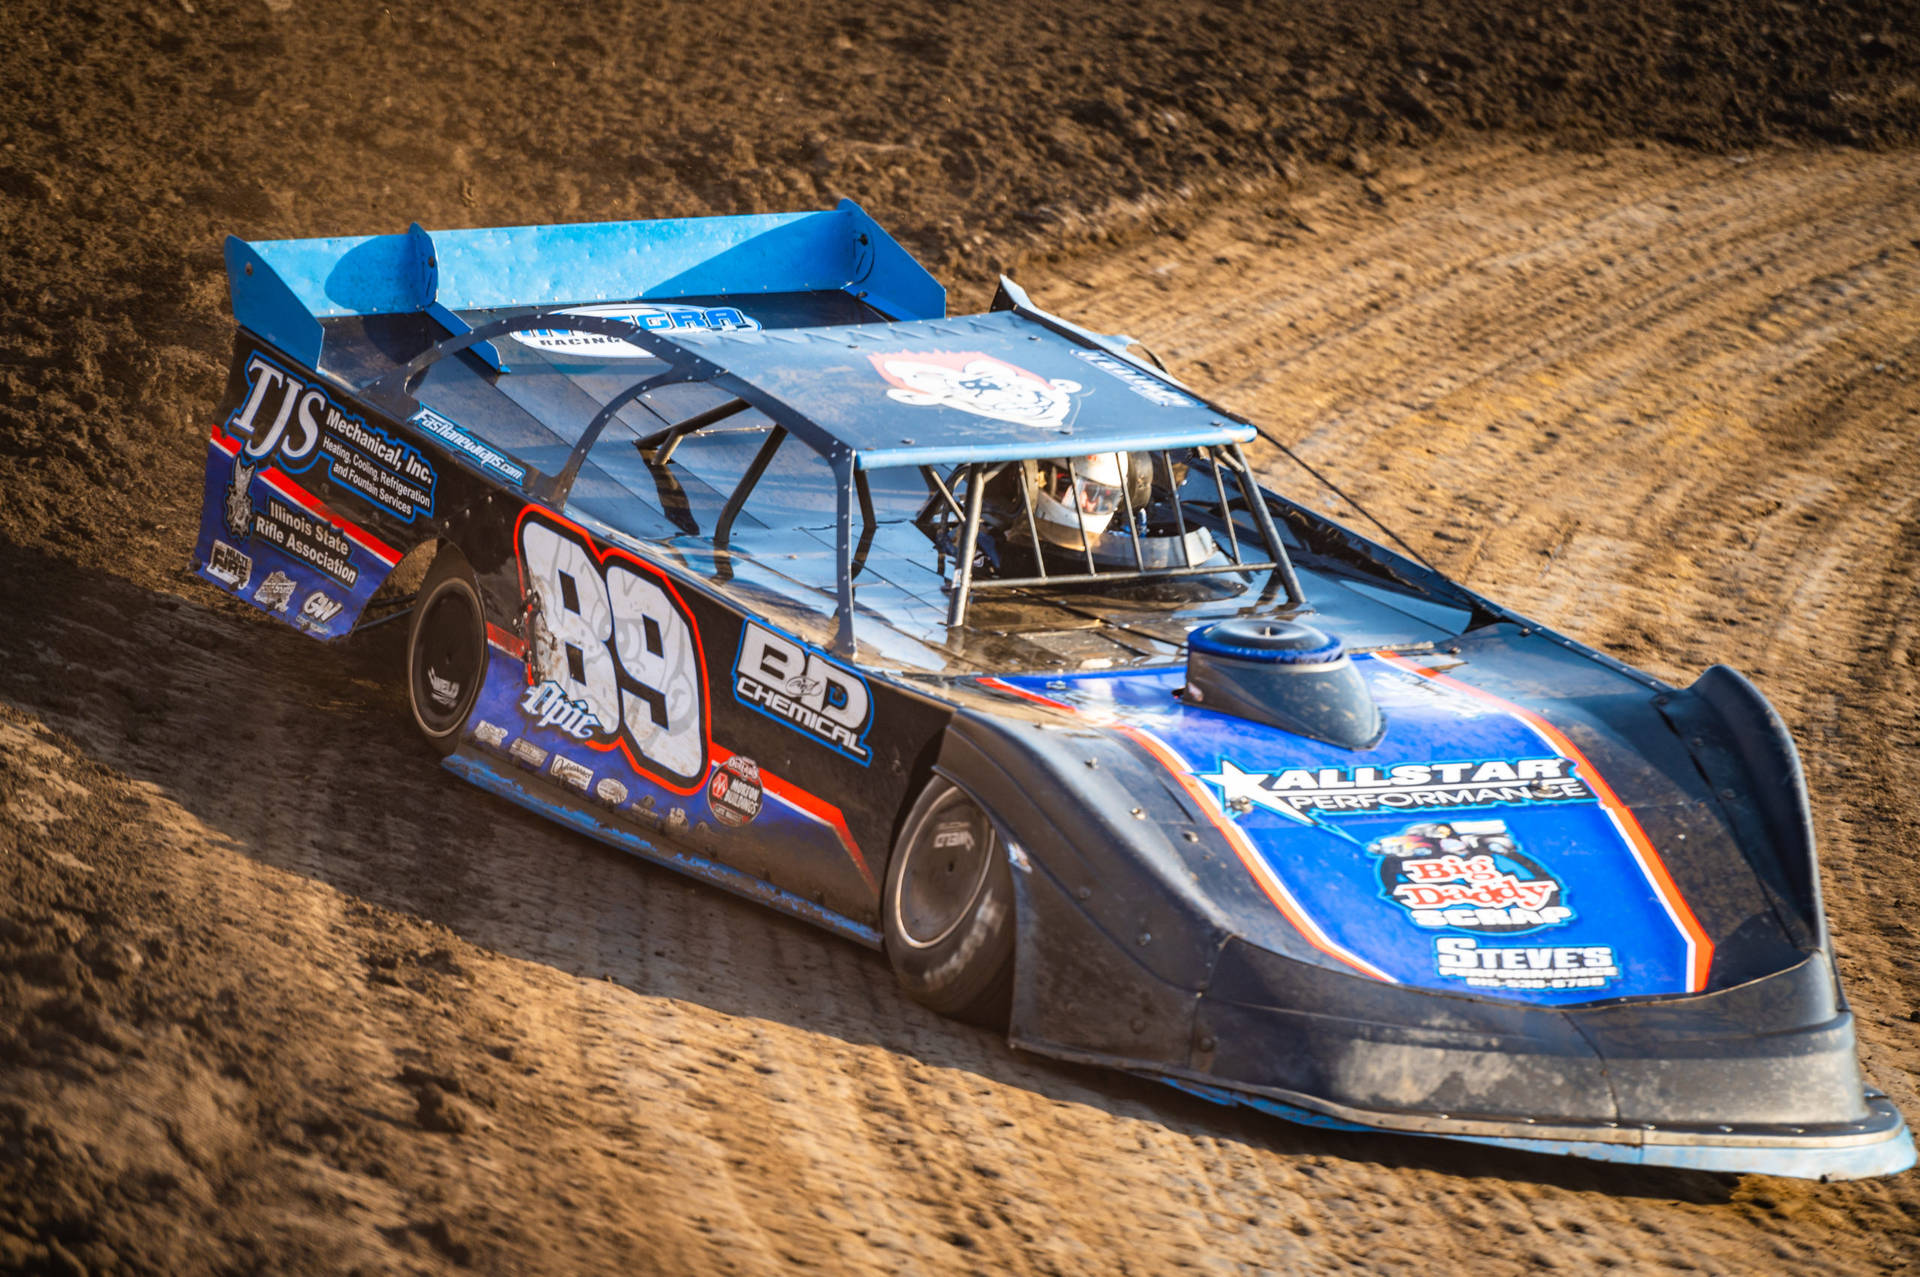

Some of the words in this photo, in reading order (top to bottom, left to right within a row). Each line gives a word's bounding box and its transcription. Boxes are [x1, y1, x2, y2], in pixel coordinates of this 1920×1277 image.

[233, 359, 326, 457] TJS
[323, 436, 351, 464] Heating,
[353, 454, 379, 482] Cooling,
[380, 471, 431, 507] Refrigeration
[326, 408, 402, 470] Mechanical,
[405, 455, 432, 484] Inc.
[333, 463, 348, 477] and
[348, 469, 378, 497] Fountain
[379, 488, 412, 514] Services
[256, 516, 284, 543] Rifle
[286, 533, 357, 584] Association
[270, 501, 312, 536] Illinois
[315, 525, 349, 555] State
[523, 521, 702, 778] 89
[737, 677, 866, 755] CHEMICAL
[1271, 759, 1562, 789] ALLSTAR
[1288, 783, 1587, 810] PERFORMANCE
[1399, 878, 1553, 908] Daddy
[1407, 857, 1497, 882] Big
[1410, 907, 1572, 926] SCRAP
